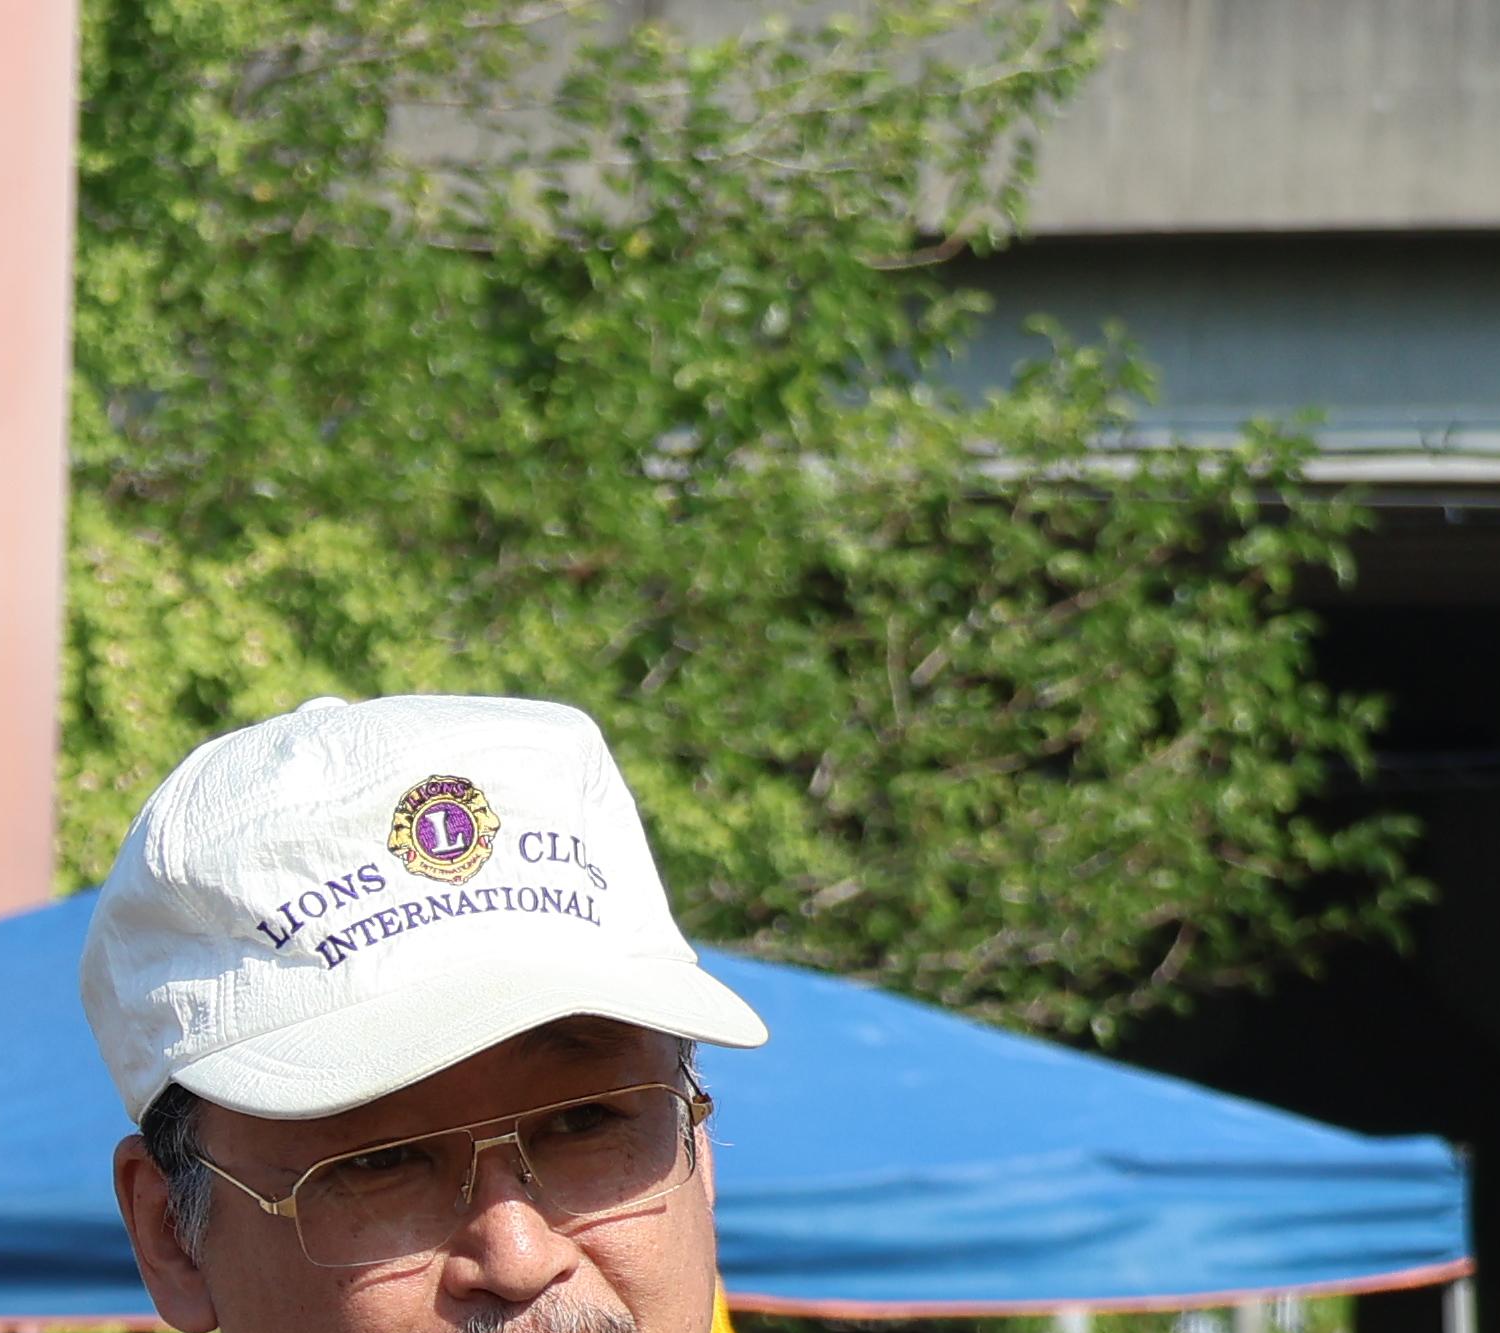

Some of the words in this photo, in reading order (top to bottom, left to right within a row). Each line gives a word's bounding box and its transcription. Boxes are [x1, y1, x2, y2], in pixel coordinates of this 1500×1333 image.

[425, 810, 465, 853] L
[256, 862, 386, 950] LIONS
[518, 831, 608, 891] CLUS
[314, 886, 602, 970] INTERNATIONAL
